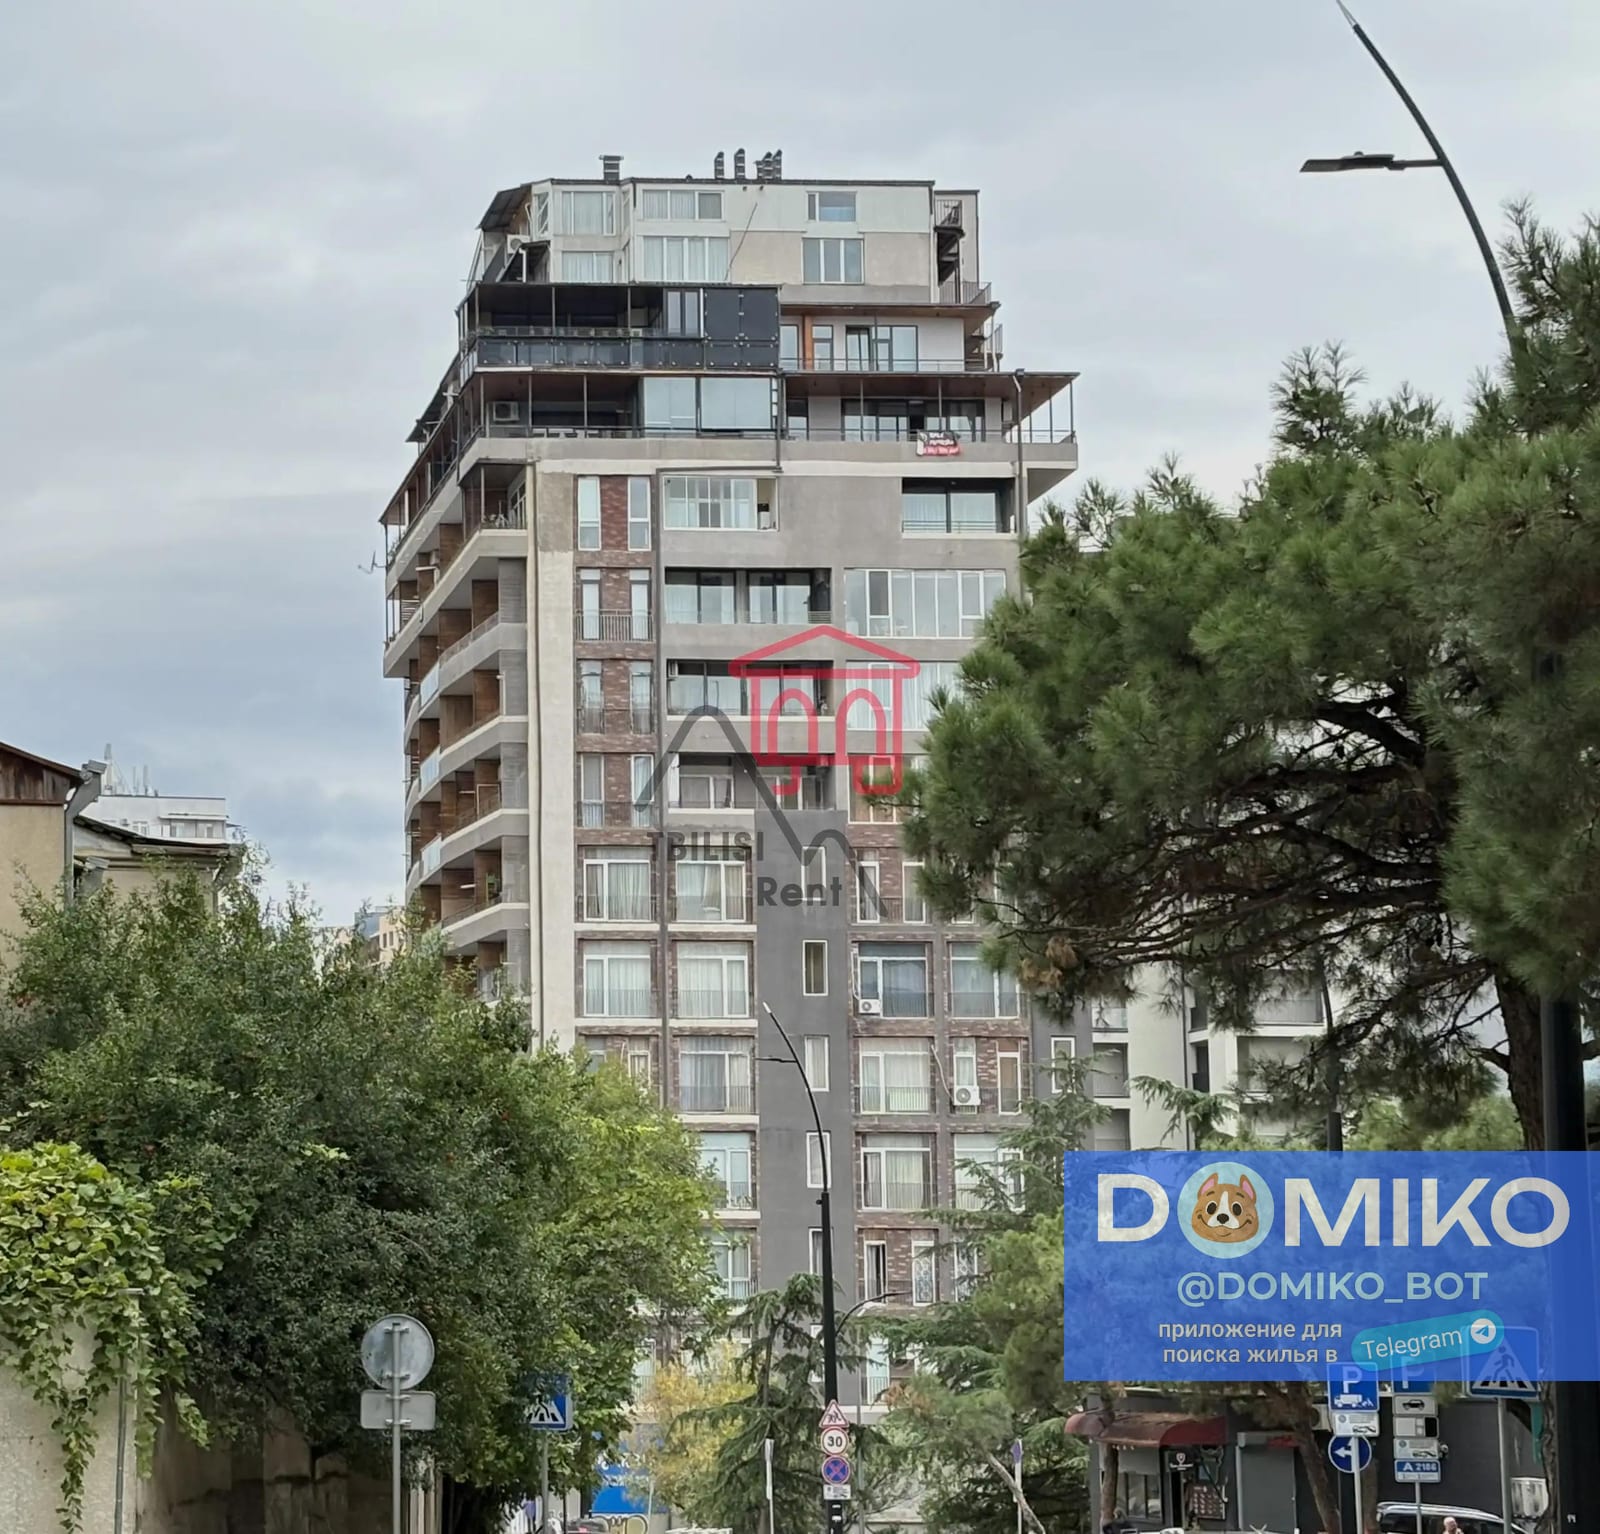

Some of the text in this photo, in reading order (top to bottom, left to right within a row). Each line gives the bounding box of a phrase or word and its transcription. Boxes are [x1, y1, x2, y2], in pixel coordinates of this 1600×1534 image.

[1342, 1366, 1362, 1393] P
[827, 1436, 843, 1447] 30
[1402, 1462, 1413, 1472] A
